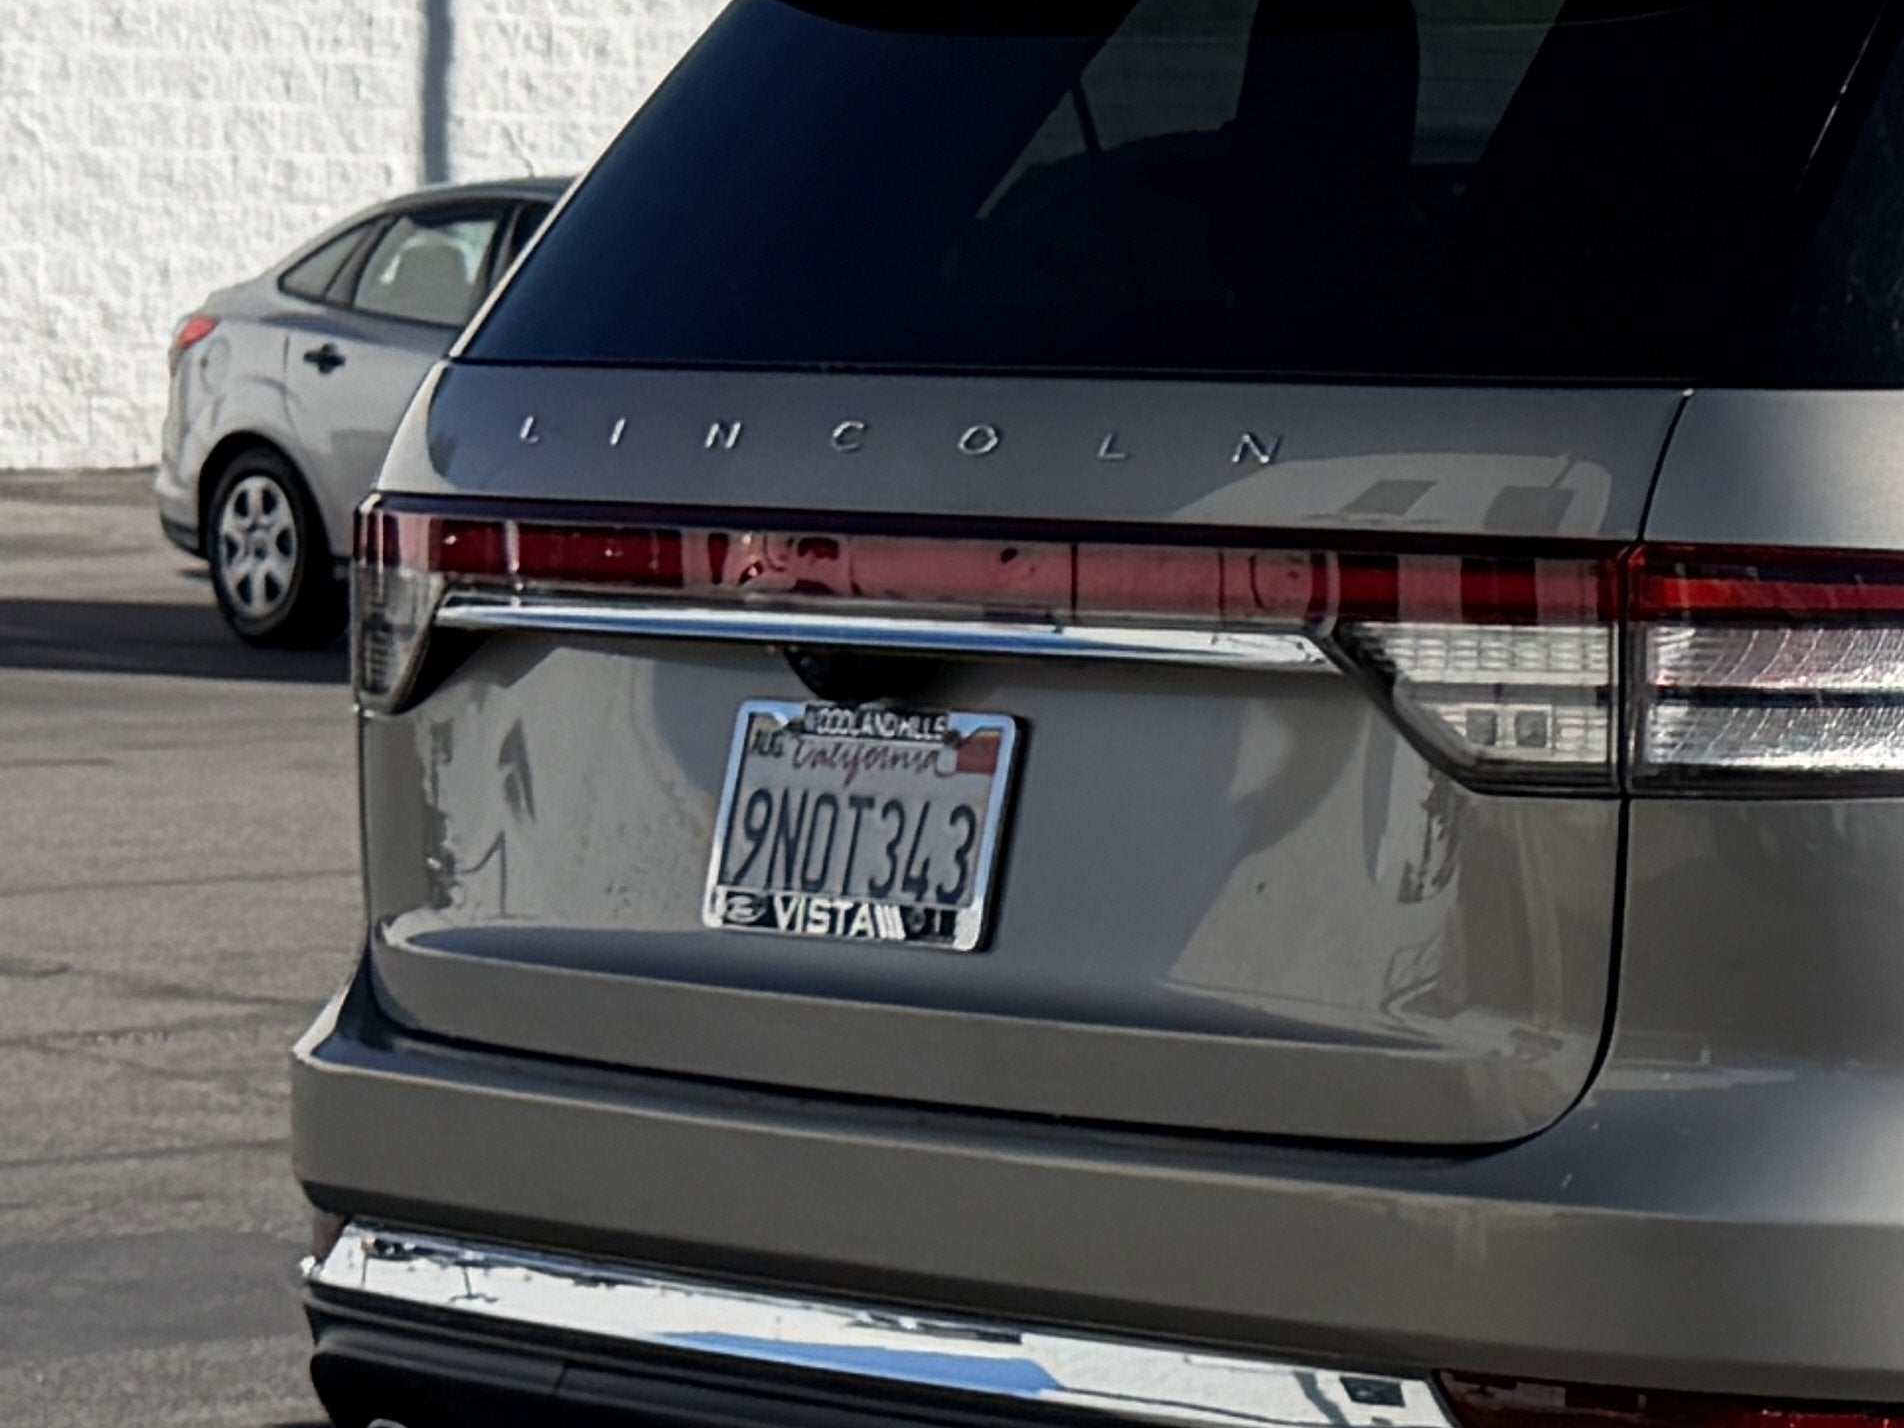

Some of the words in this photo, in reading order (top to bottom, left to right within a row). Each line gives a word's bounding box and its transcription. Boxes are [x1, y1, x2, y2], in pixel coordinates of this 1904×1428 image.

[519, 415, 1283, 465] LINCOLN
[791, 736, 953, 787] California
[773, 895, 876, 939] VISTA
